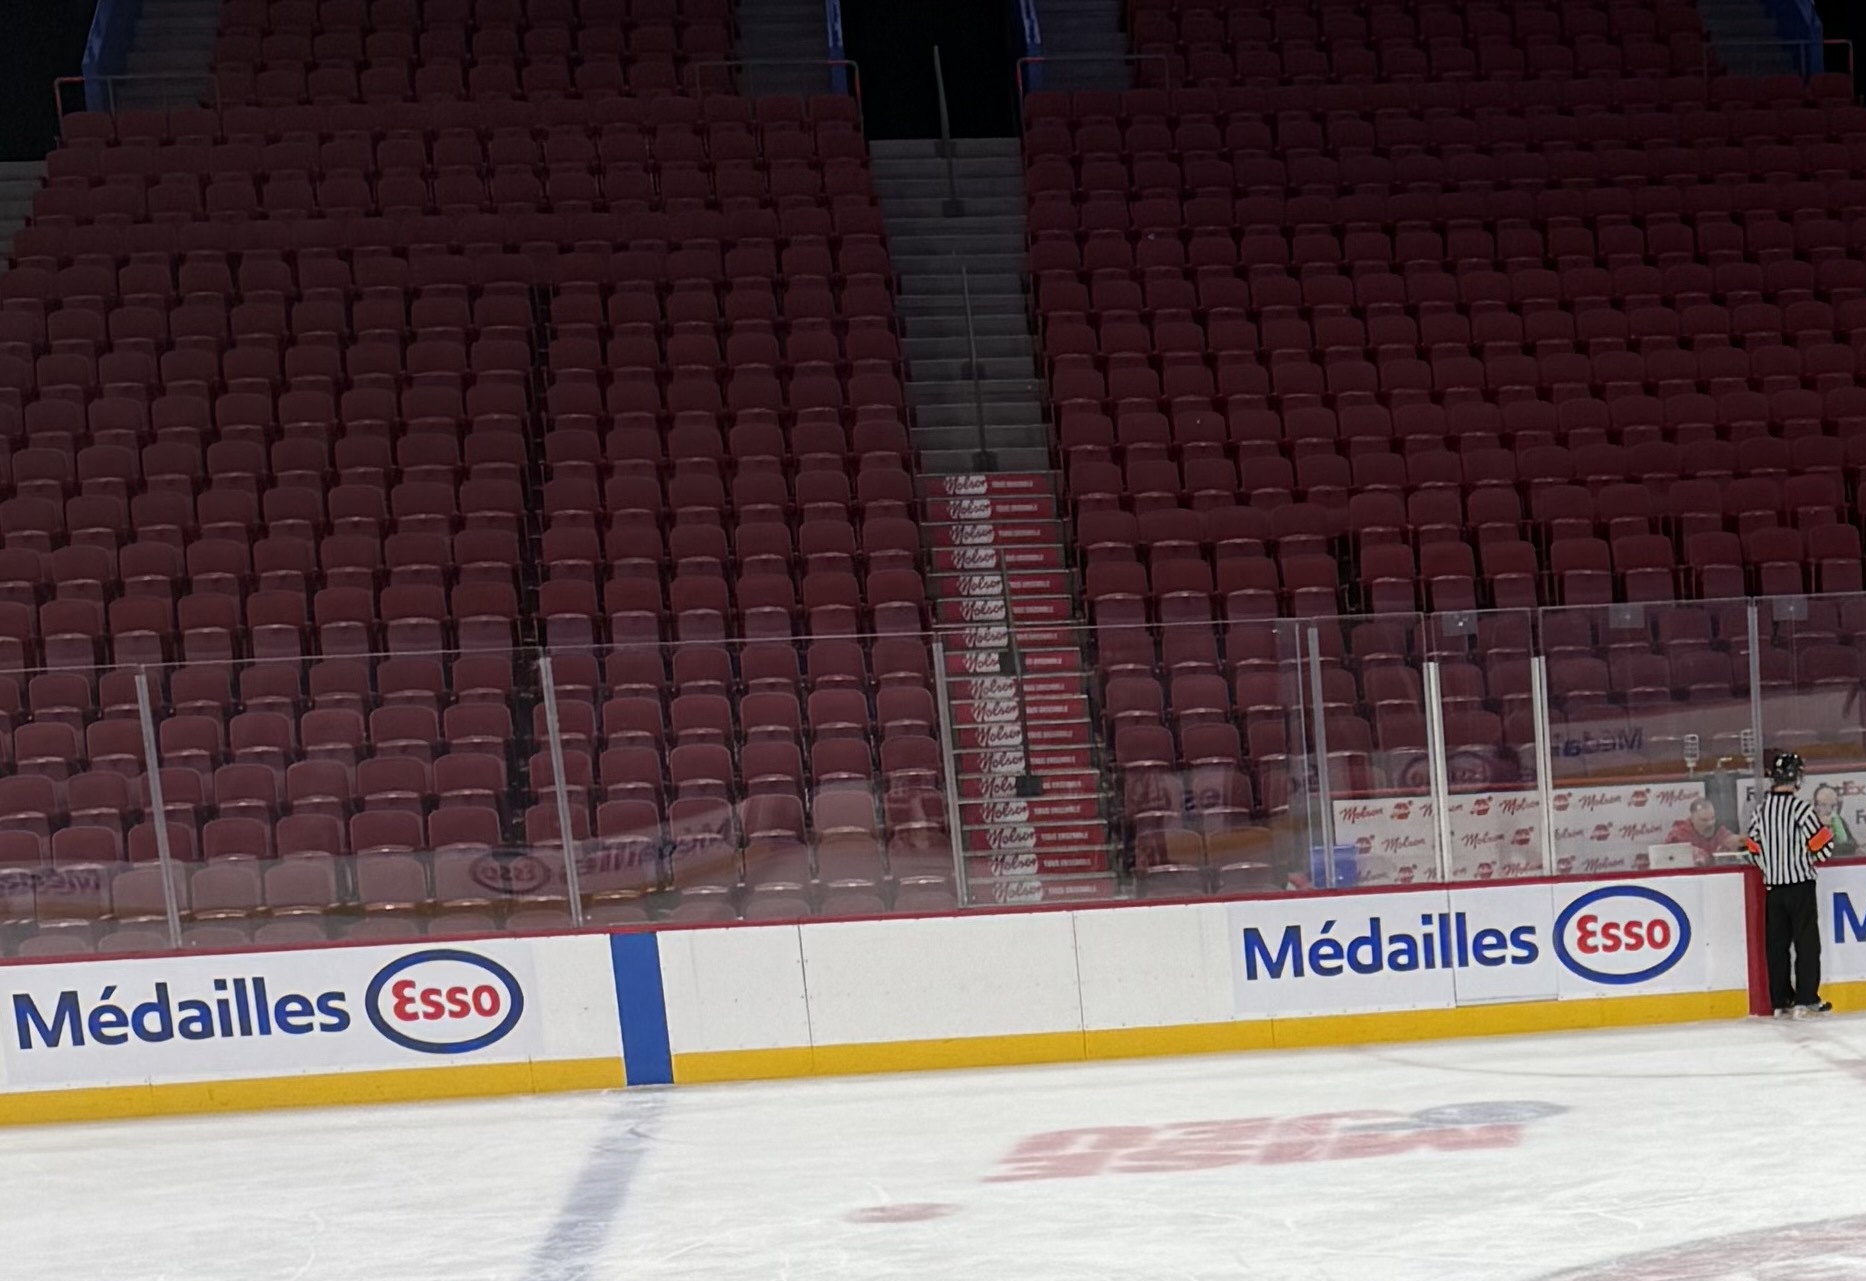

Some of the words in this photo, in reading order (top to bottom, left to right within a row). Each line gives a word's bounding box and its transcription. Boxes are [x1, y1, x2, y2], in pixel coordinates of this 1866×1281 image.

[981, 776, 1017, 797] Mols
[1243, 912, 1539, 981] Médailles
[1576, 914, 1671, 954] Esso
[14, 976, 350, 1051] Médailles
[391, 979, 501, 1022] Esso
